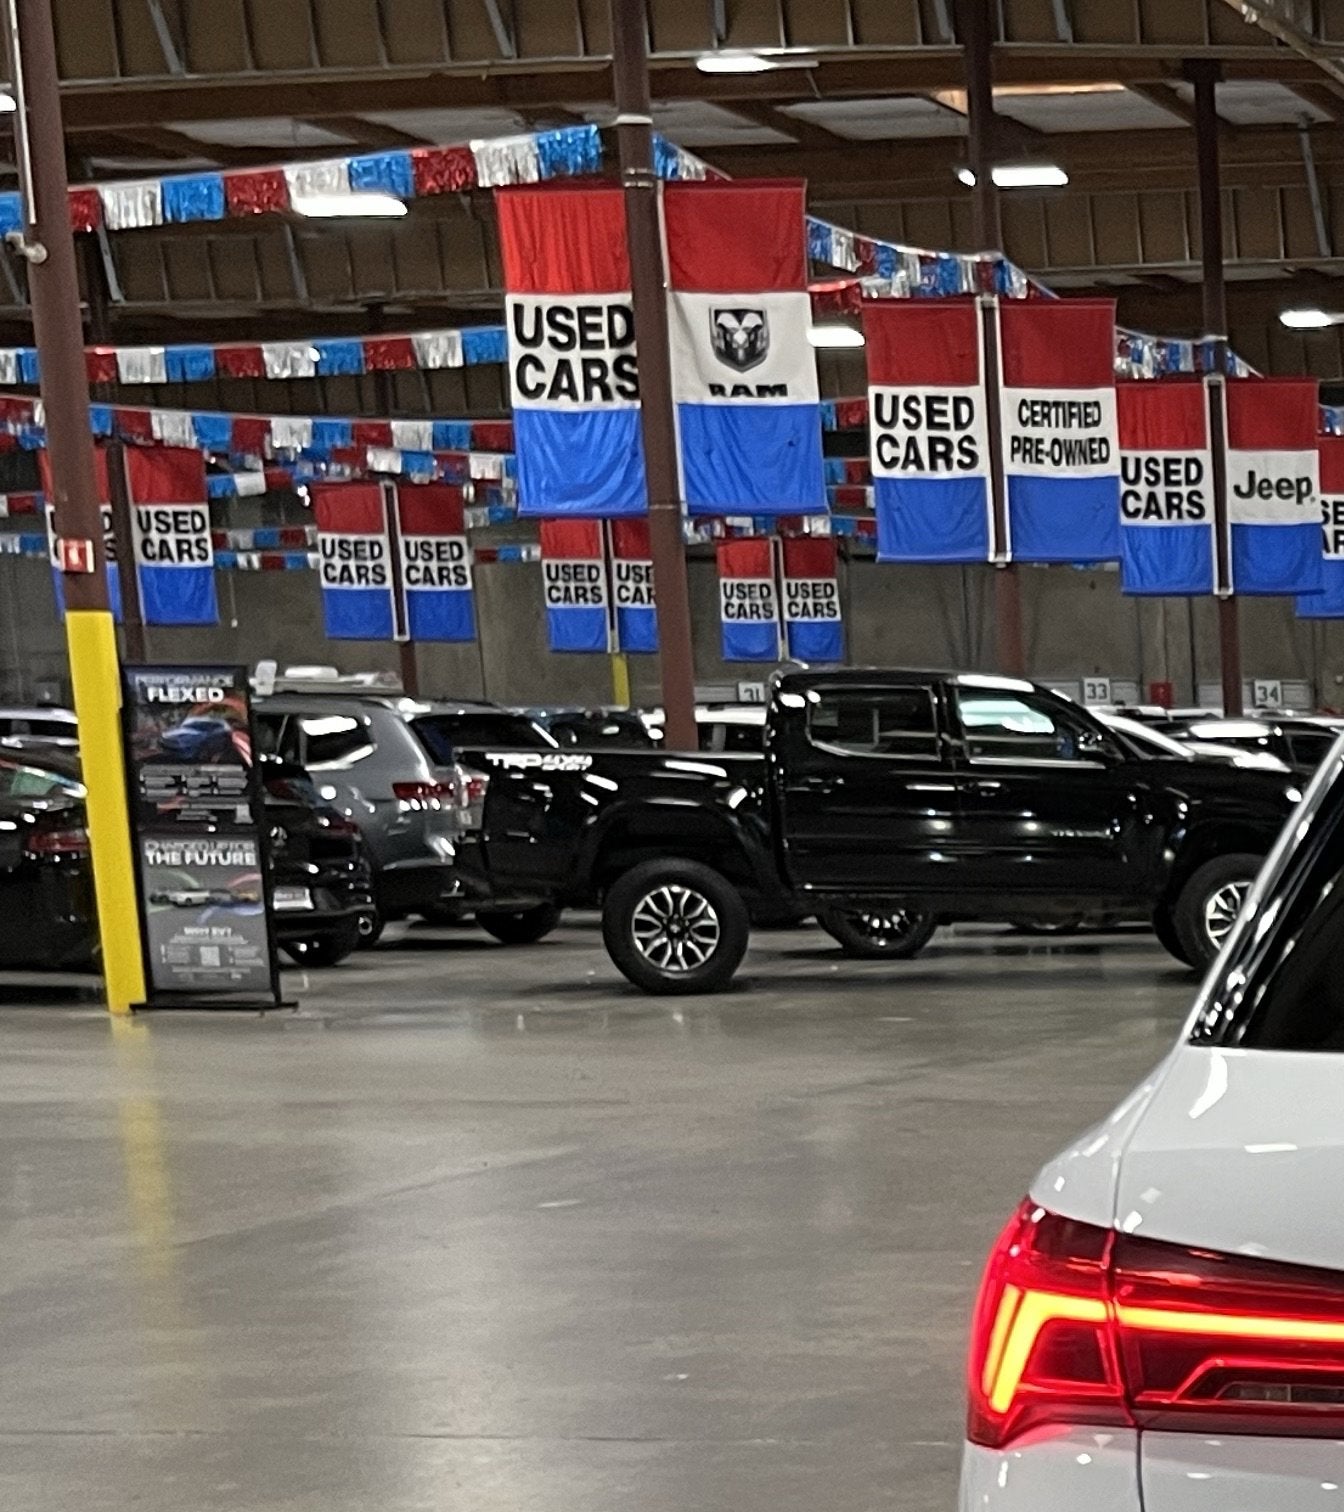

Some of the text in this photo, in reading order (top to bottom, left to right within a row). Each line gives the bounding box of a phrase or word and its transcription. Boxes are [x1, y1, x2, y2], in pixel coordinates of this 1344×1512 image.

[512, 303, 636, 351] USED
[515, 353, 640, 402] CARS
[708, 382, 788, 398] RAM
[874, 393, 975, 431] USED
[1018, 398, 1101, 429] CERTIFIED
[876, 433, 979, 472] CARS
[1011, 435, 1111, 467] PRE-OWNED
[1120, 456, 1204, 487] USED
[1233, 470, 1313, 505] Jeep
[1121, 489, 1206, 520] CARS
[137, 510, 207, 535] USED
[141, 537, 209, 563] CARS
[321, 538, 384, 561] USED
[404, 540, 464, 562] USED
[323, 562, 387, 586] CARS
[405, 564, 468, 587] CARS
[545, 563, 601, 583] USED
[547, 584, 603, 605] CARS
[722, 582, 772, 601] USED
[786, 582, 835, 600] USED
[724, 602, 774, 620] CARS
[787, 601, 838, 619] CARS
[146, 687, 225, 702] FLEXED
[1087, 683, 1108, 700] 33
[1257, 686, 1279, 703] 34
[145, 849, 257, 866] THE FUTURE
